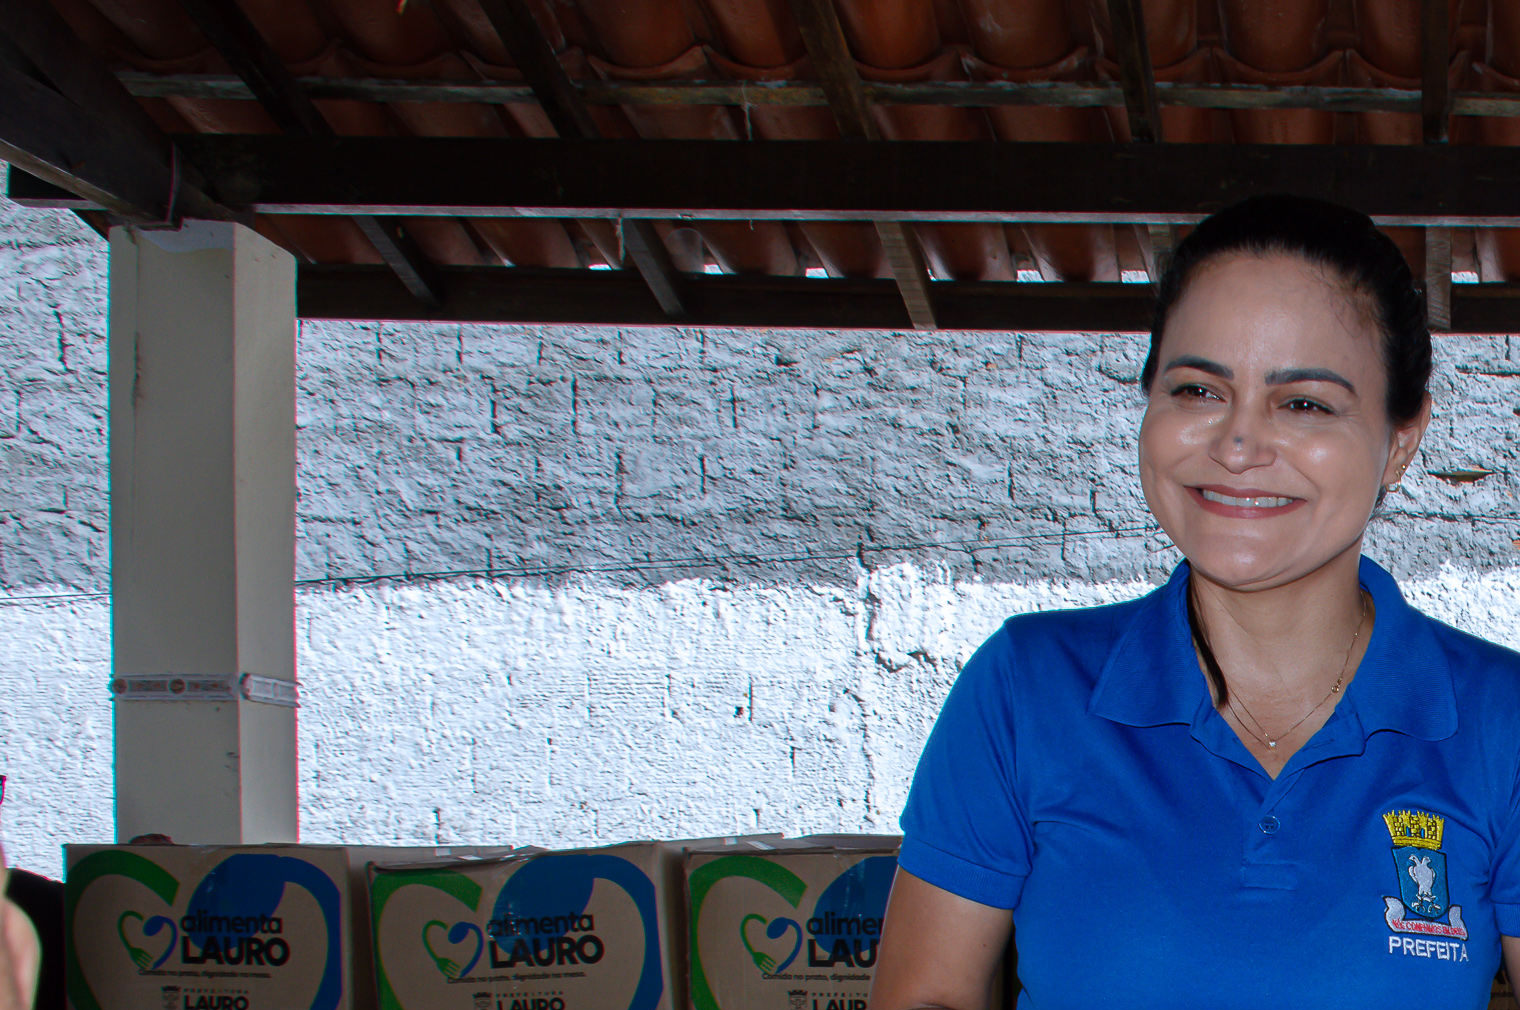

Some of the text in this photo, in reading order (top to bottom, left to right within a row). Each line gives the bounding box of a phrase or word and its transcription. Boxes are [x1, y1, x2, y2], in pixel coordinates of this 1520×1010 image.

[180, 910, 283, 934] alimenta
[486, 911, 595, 937] alimenta
[806, 911, 884, 935] alime
[181, 936, 290, 966] LAURO
[488, 935, 605, 968] LAURO
[808, 939, 879, 968] LAU
[1389, 936, 1469, 962] PREFEITA
